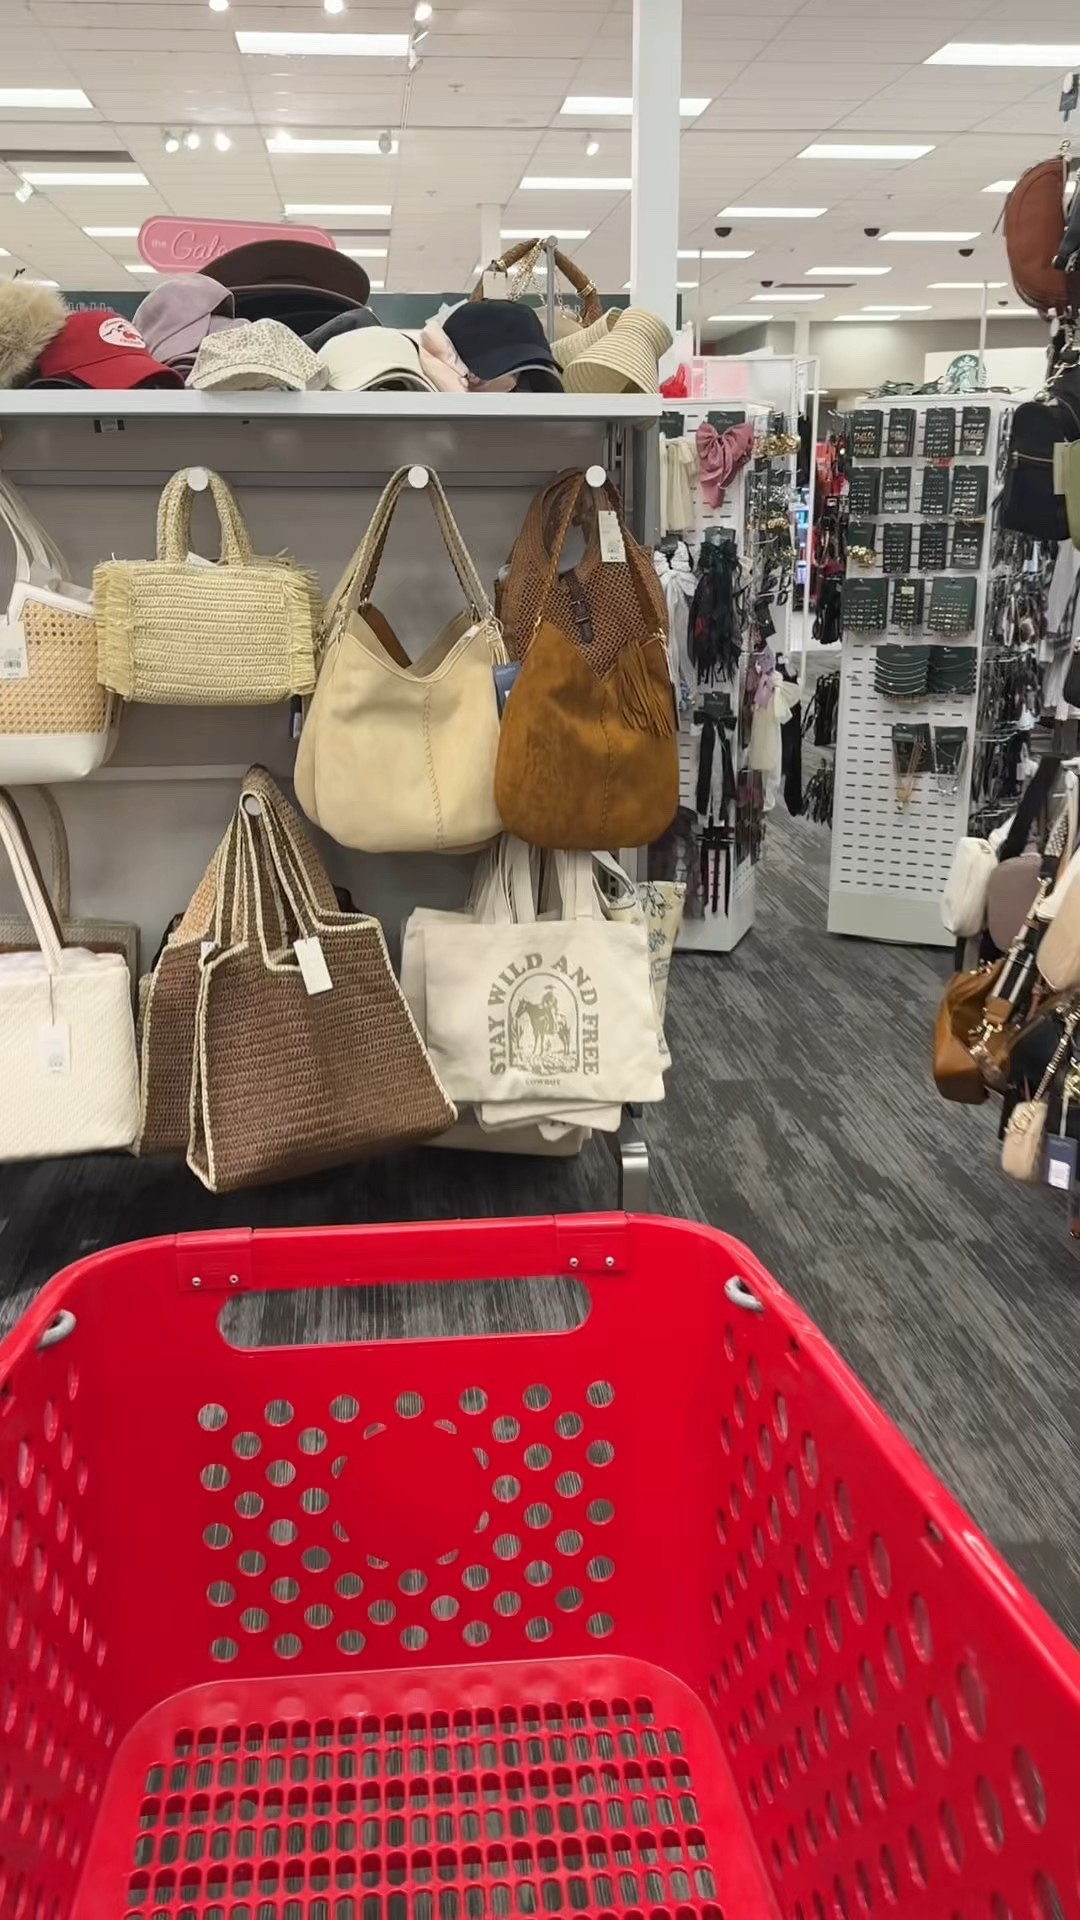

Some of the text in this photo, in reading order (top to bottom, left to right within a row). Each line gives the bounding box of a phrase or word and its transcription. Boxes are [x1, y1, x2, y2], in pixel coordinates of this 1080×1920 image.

[151, 238, 166, 248] the
[487, 952, 599, 1075] STAY WILD AND FREE
